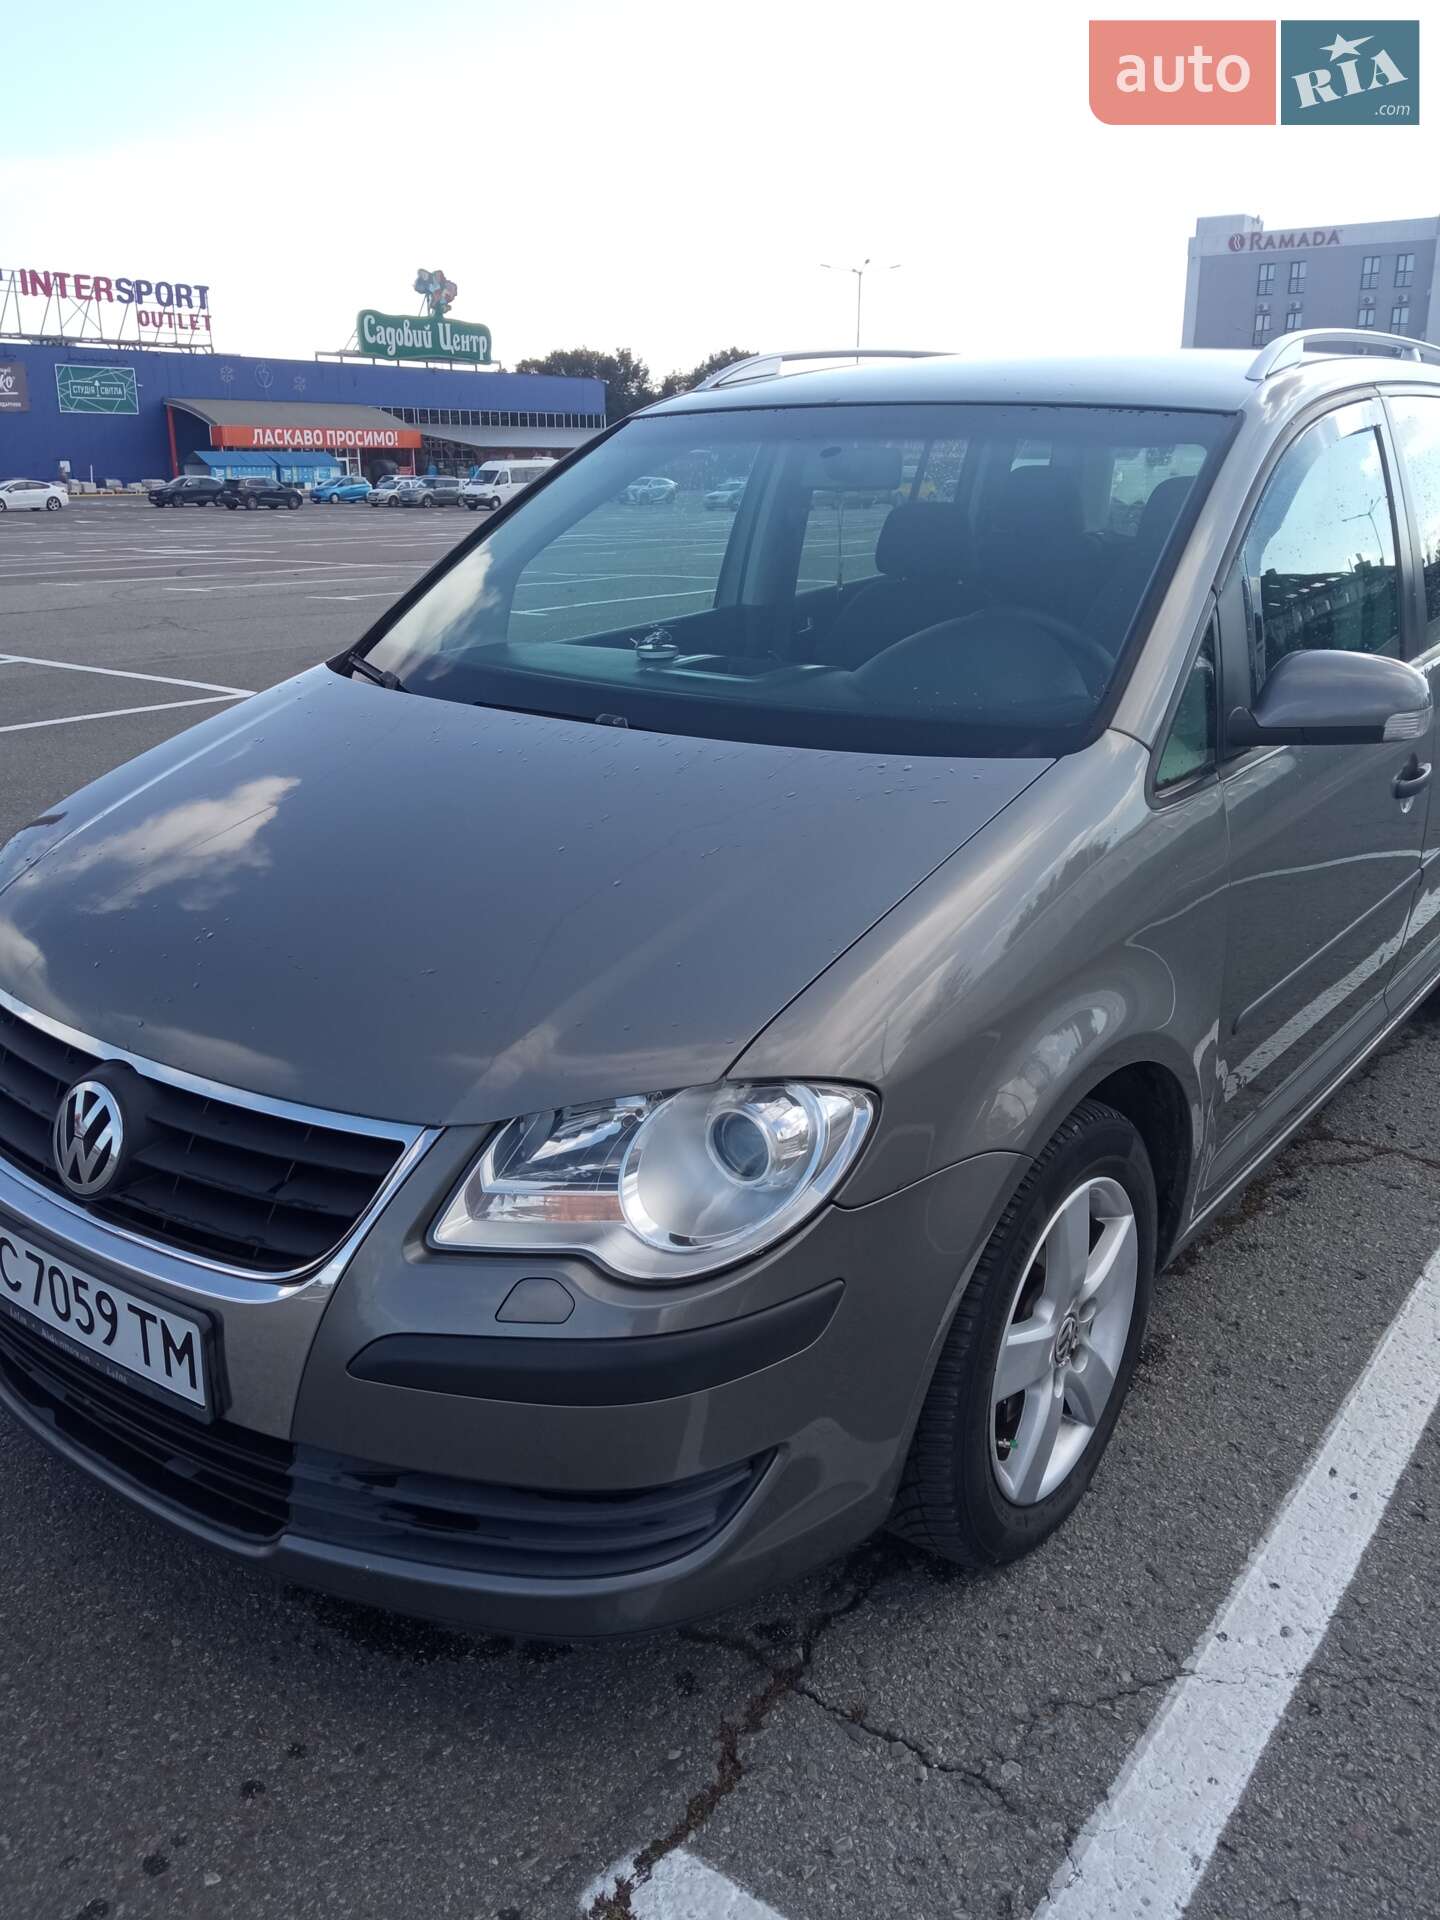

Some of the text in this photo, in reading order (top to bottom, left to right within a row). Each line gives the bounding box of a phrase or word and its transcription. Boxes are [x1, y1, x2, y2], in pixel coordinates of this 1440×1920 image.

[1249, 229, 1341, 251] RAMADA
[20, 268, 209, 310] INTERSPORT
[138, 310, 212, 332] OUTLET
[363, 314, 488, 361] Садовий Центр
[252, 428, 399, 447] ЛАСКАВО ПРОСИМО!
